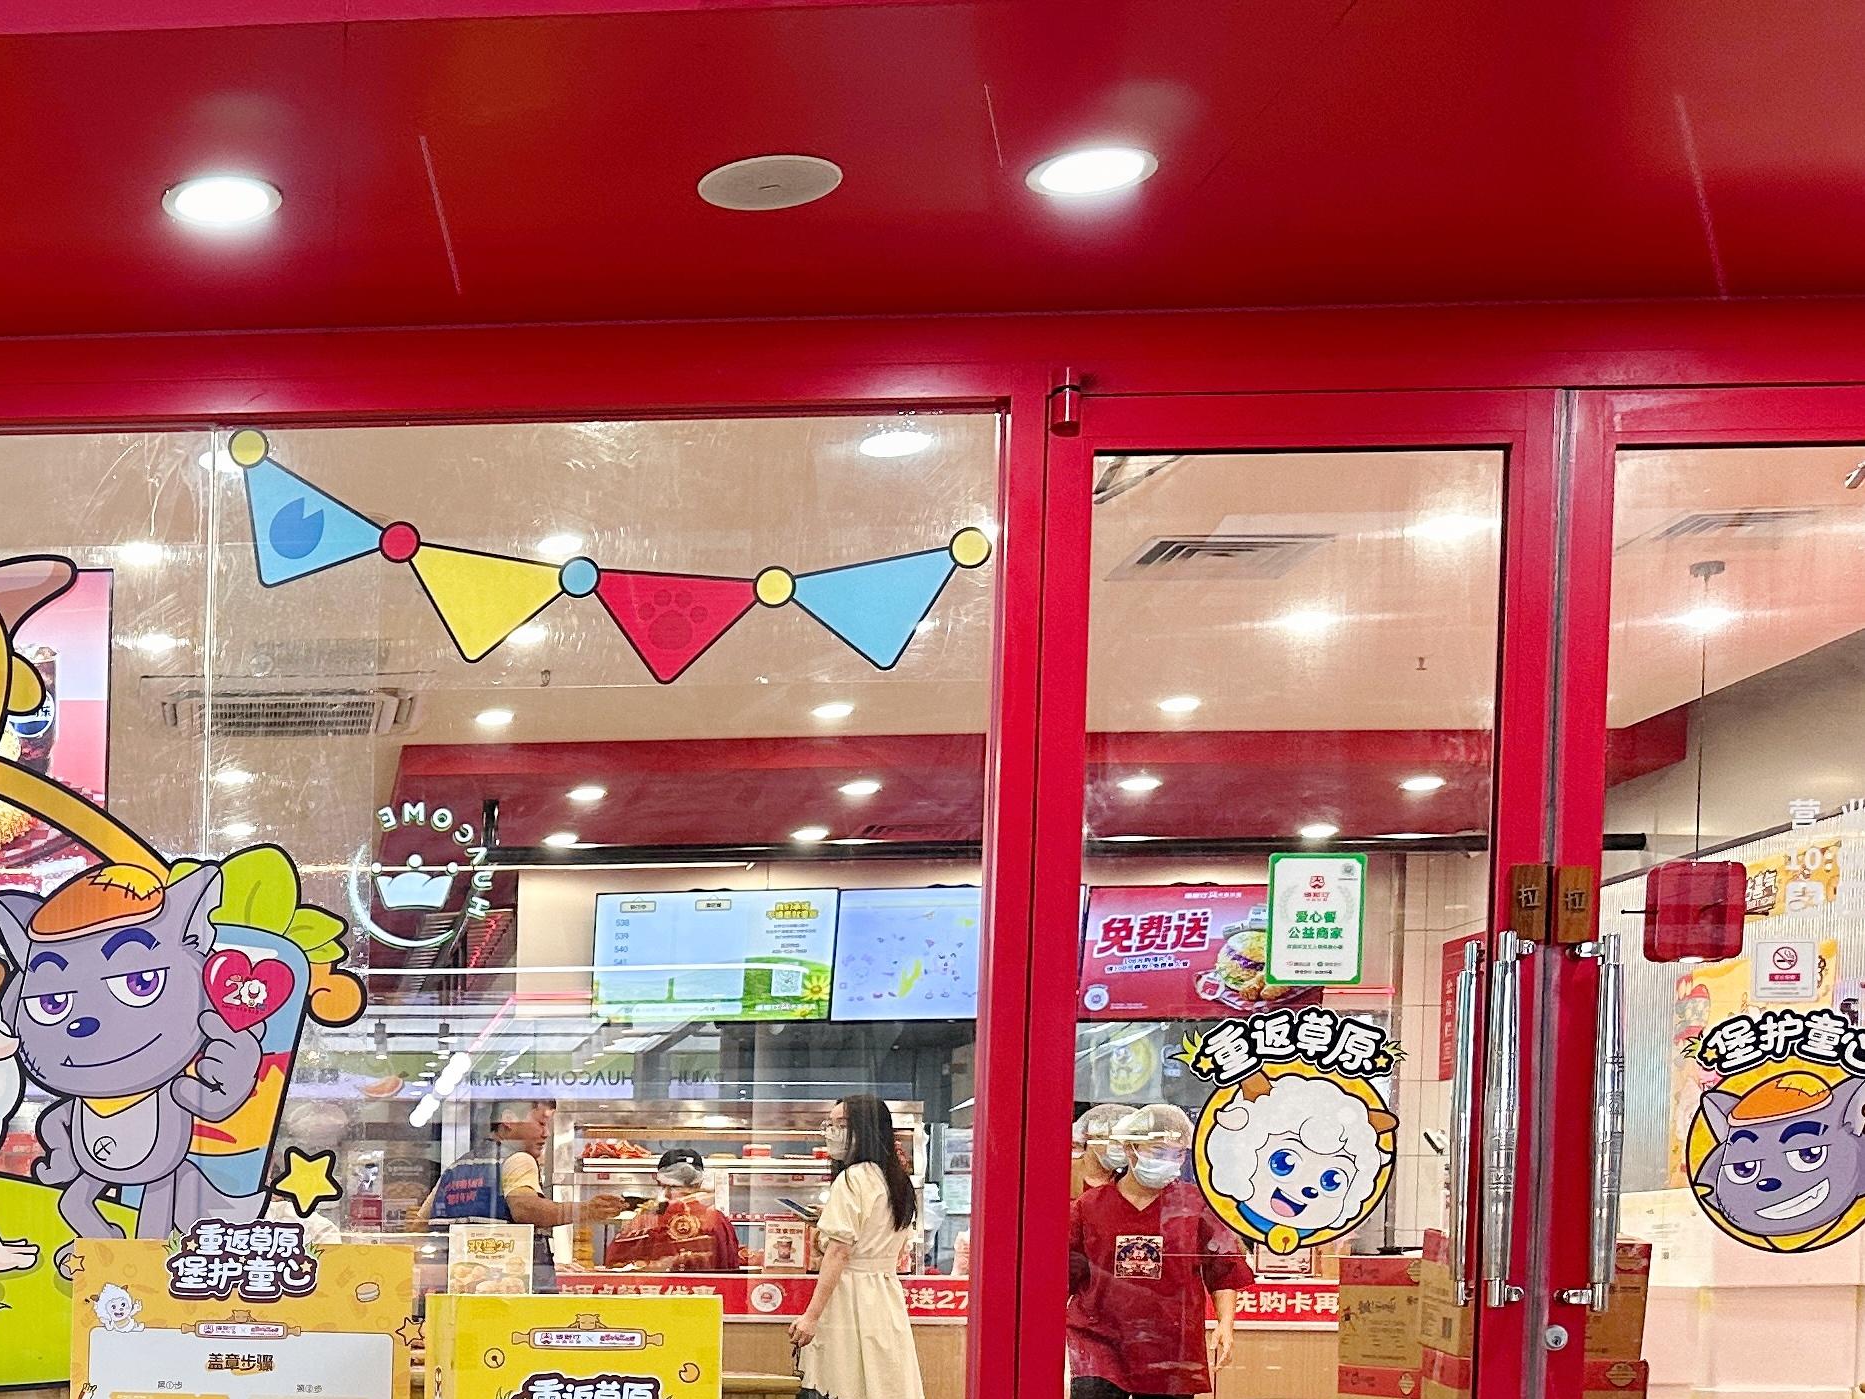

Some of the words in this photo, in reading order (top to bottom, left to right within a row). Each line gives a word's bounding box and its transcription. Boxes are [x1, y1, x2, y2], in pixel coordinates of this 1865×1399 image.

[1518, 884, 1540, 908] 拉
[1564, 887, 1586, 912] 拉
[1096, 910, 1210, 955] 免费送
[1204, 1011, 1379, 1080] 重返草原
[195, 1223, 301, 1257] 重返草原
[173, 1257, 310, 1292] 堡护童心
[1234, 1291, 1338, 1314] 先购卡再
[207, 1353, 274, 1372] 盖章步骤
